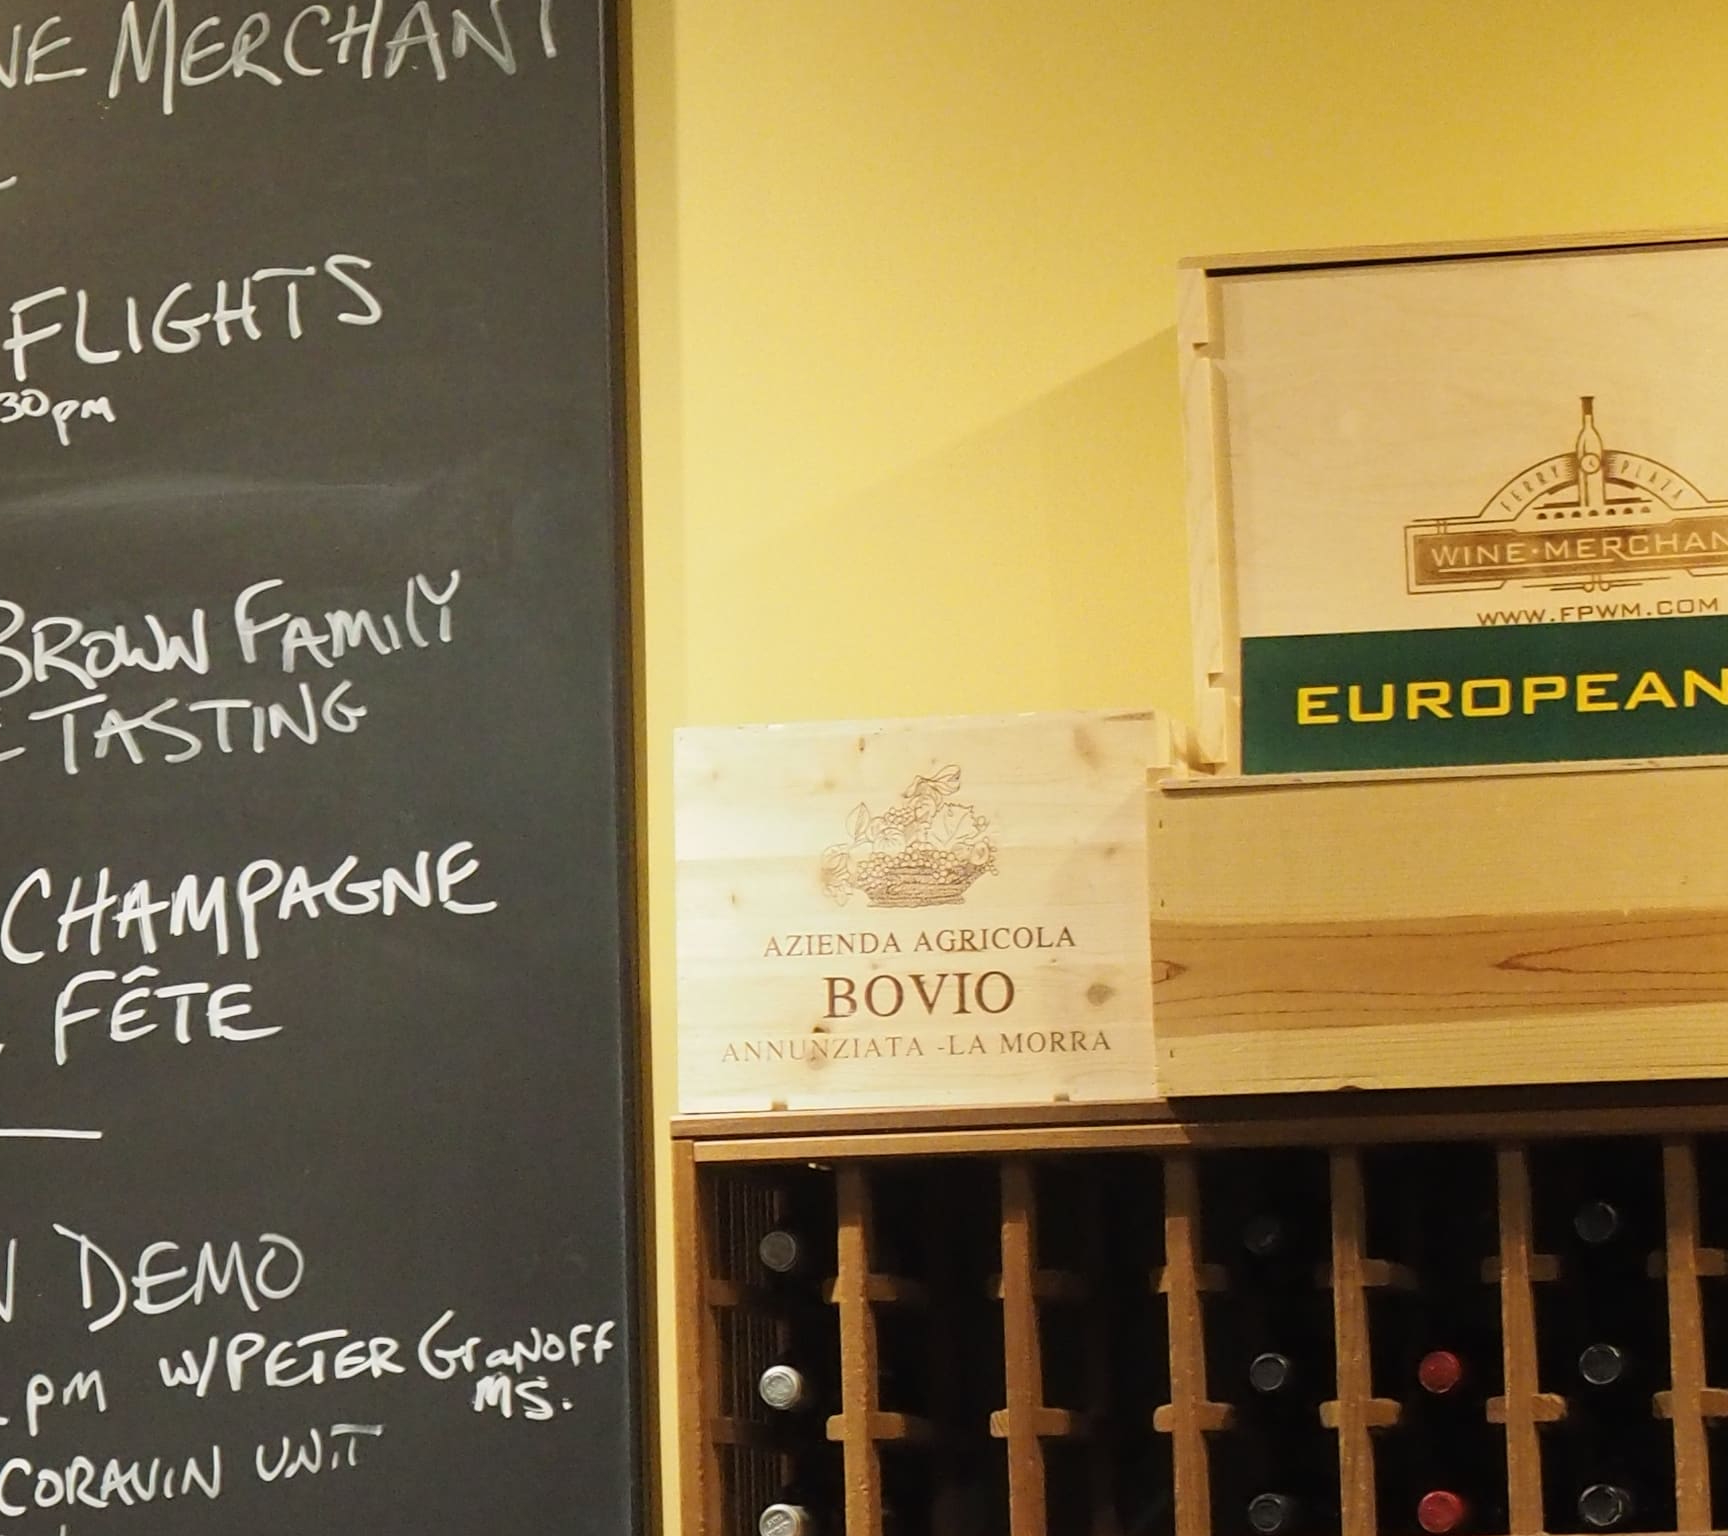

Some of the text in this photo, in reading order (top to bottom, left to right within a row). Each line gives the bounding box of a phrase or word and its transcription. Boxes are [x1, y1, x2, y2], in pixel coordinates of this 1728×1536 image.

[3, 254, 382, 382] FLIGHTS
[1499, 458, 1685, 514] FERRY PLAZA
[1477, 597, 1719, 626] WWW.FPWM.COM
[1295, 667, 1728, 726] EUROPEAN
[28, 679, 367, 775] TASTING
[0, 841, 498, 964] CHAMPAGNE
[763, 926, 1077, 957] AZIENDA AGRICOLA
[823, 970, 1016, 1019] BOVIO
[721, 1035, 925, 1064] ANNUNZIATA
[1000, 1030, 1112, 1055] MORRA
[53, 1223, 303, 1332] DEMO
[255, 1424, 384, 1482] UNIT
